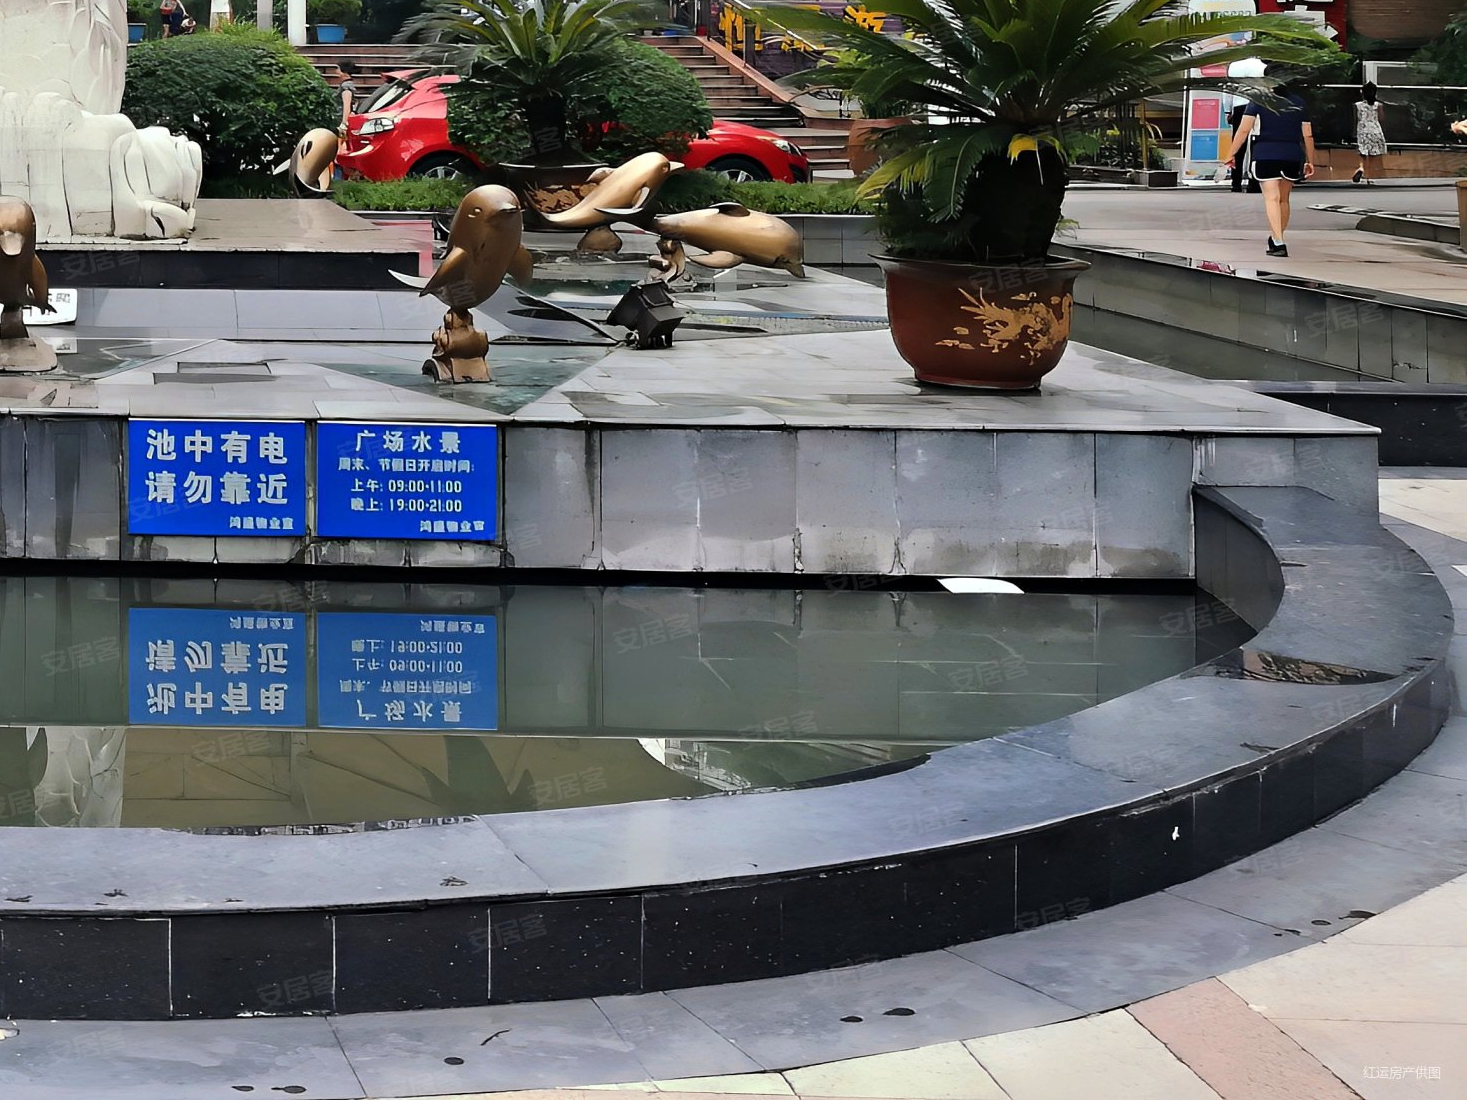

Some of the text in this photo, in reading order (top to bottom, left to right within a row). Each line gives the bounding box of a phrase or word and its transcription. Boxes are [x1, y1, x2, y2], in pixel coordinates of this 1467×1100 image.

[146, 428, 288, 465] 池中有电
[355, 429, 461, 454] 广场水景
[145, 470, 288, 505] 请勿靠近
